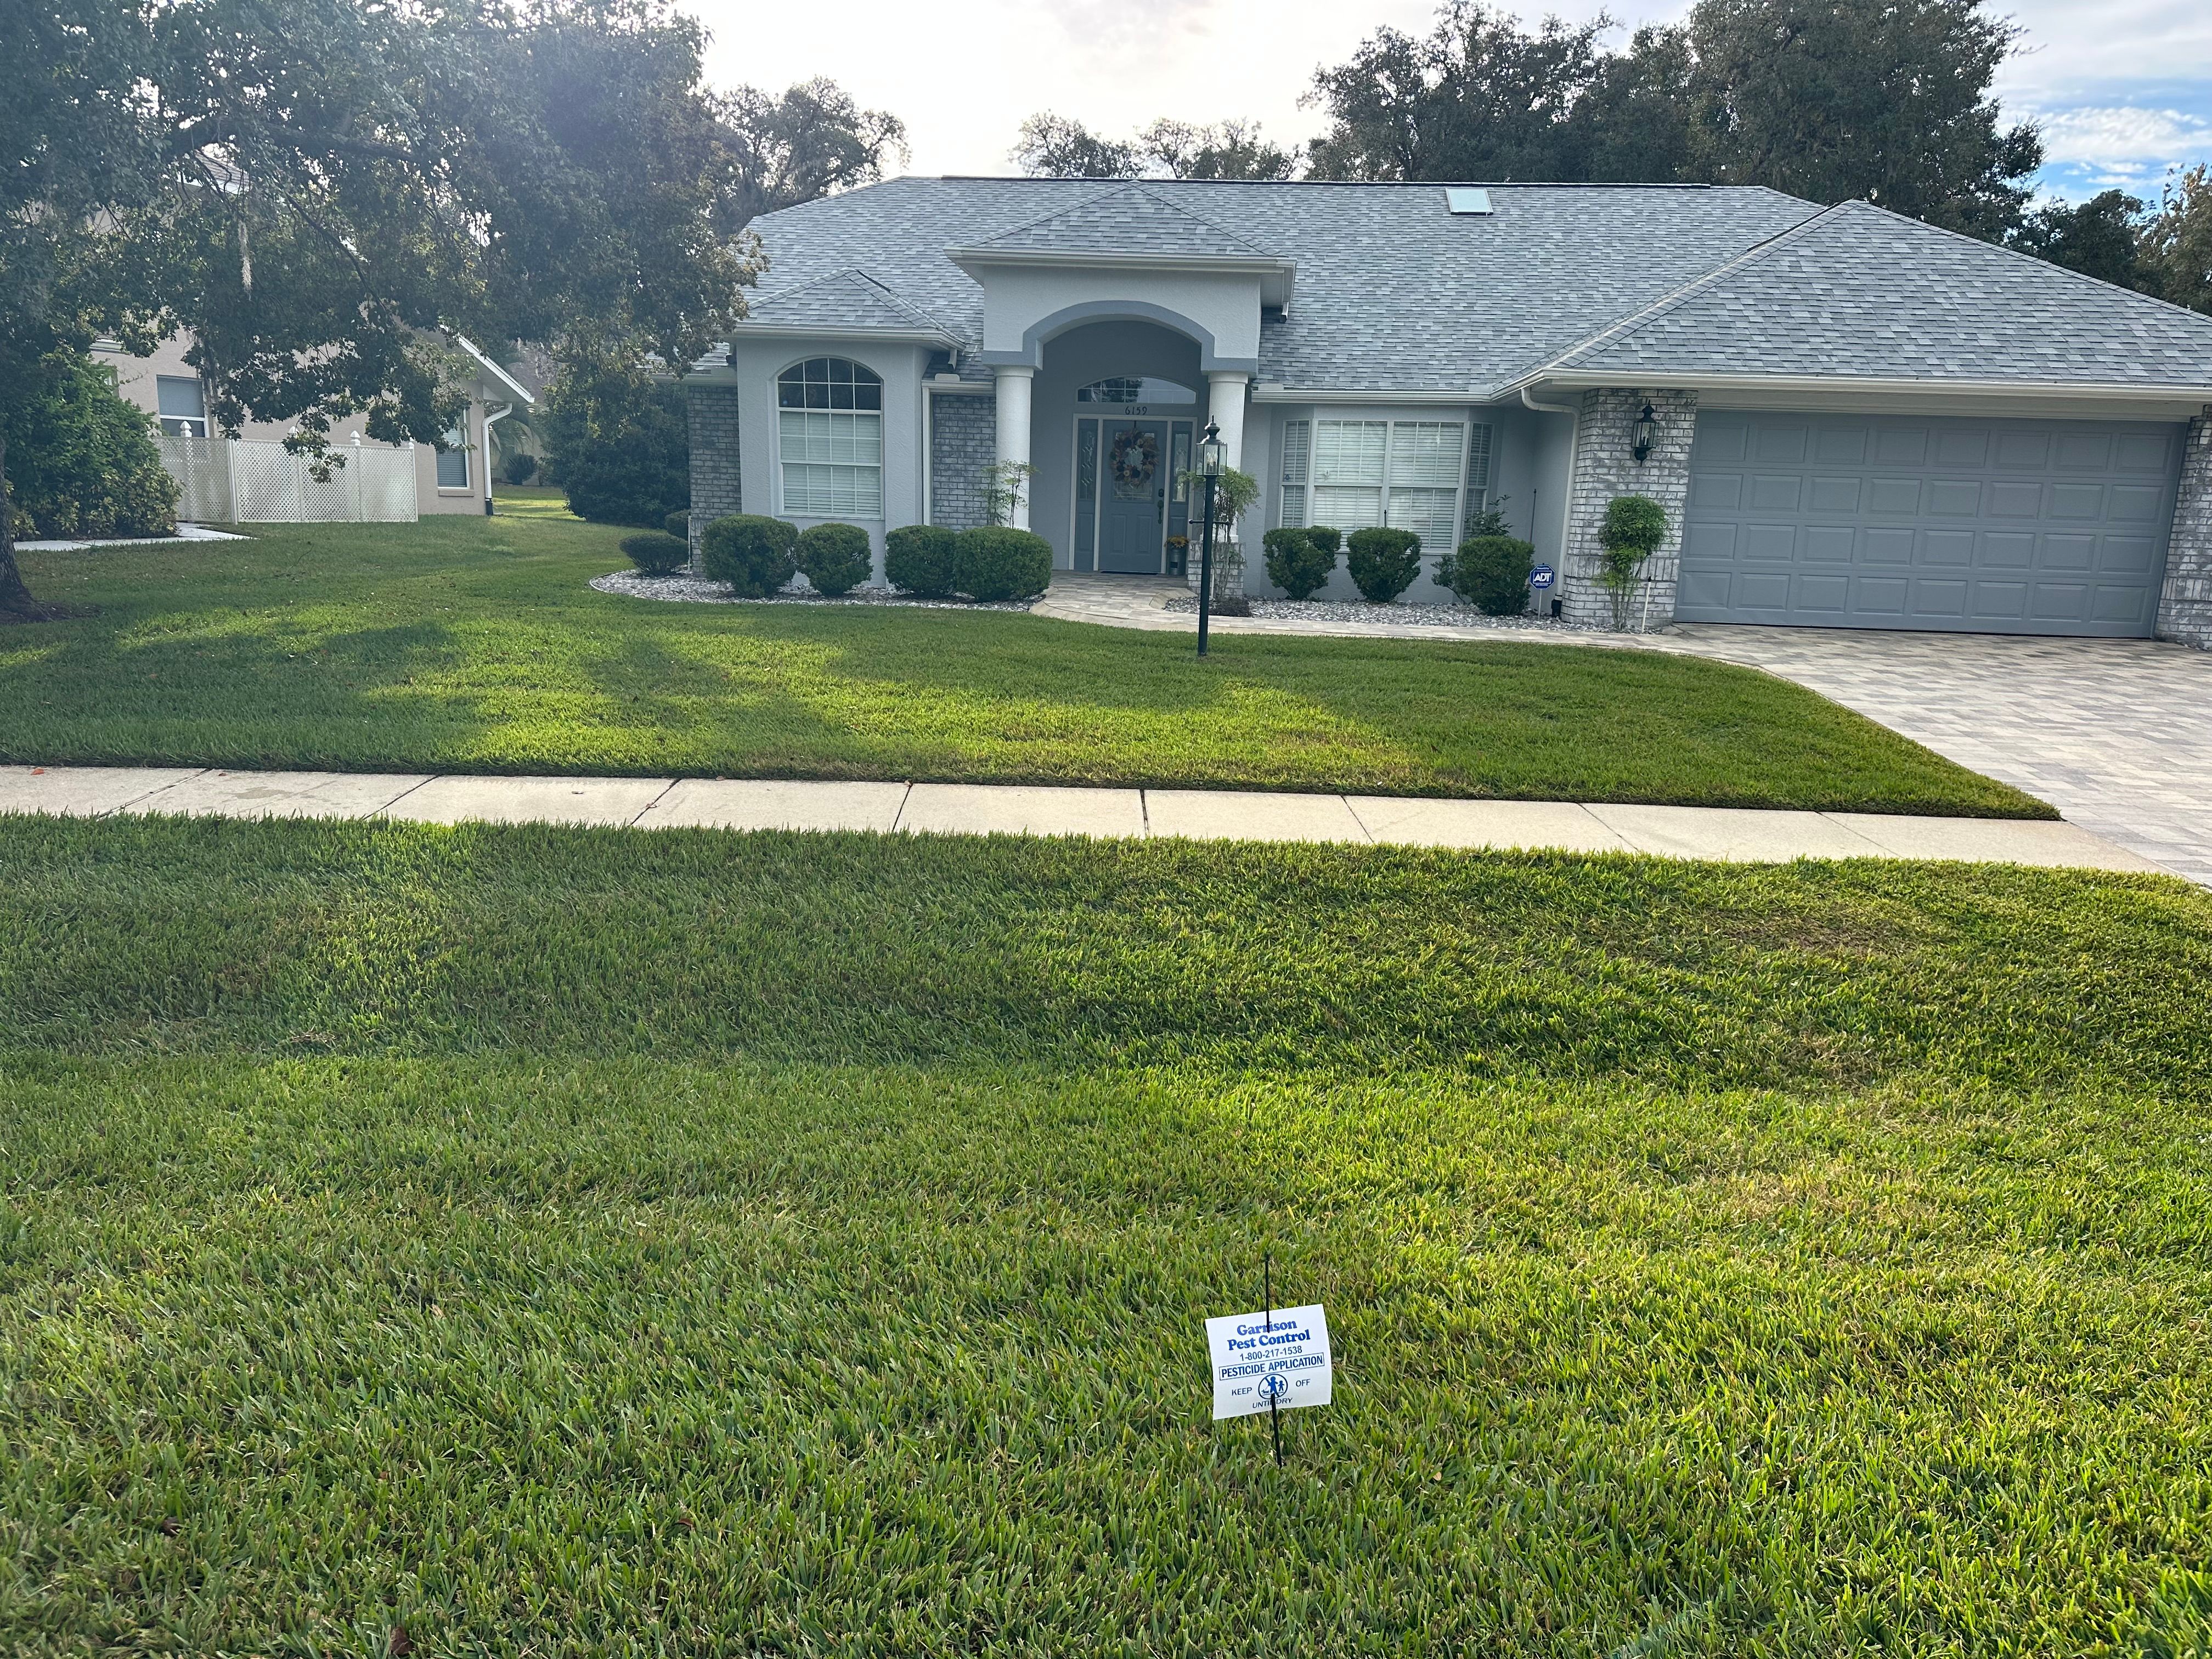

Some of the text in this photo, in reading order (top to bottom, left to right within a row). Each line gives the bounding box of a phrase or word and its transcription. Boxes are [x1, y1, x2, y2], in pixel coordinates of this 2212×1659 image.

[1125, 406, 1147, 415] 6159
[1534, 573, 1551, 582] ADT
[1237, 1321, 1297, 1335] Garrison
[1227, 1329, 1311, 1351] Pest Control
[1240, 1346, 1302, 1361] 1-800-217-1538
[1222, 1355, 1323, 1378] PESTICIDE APPLICATION
[1232, 1387, 1252, 1396] KEEP
